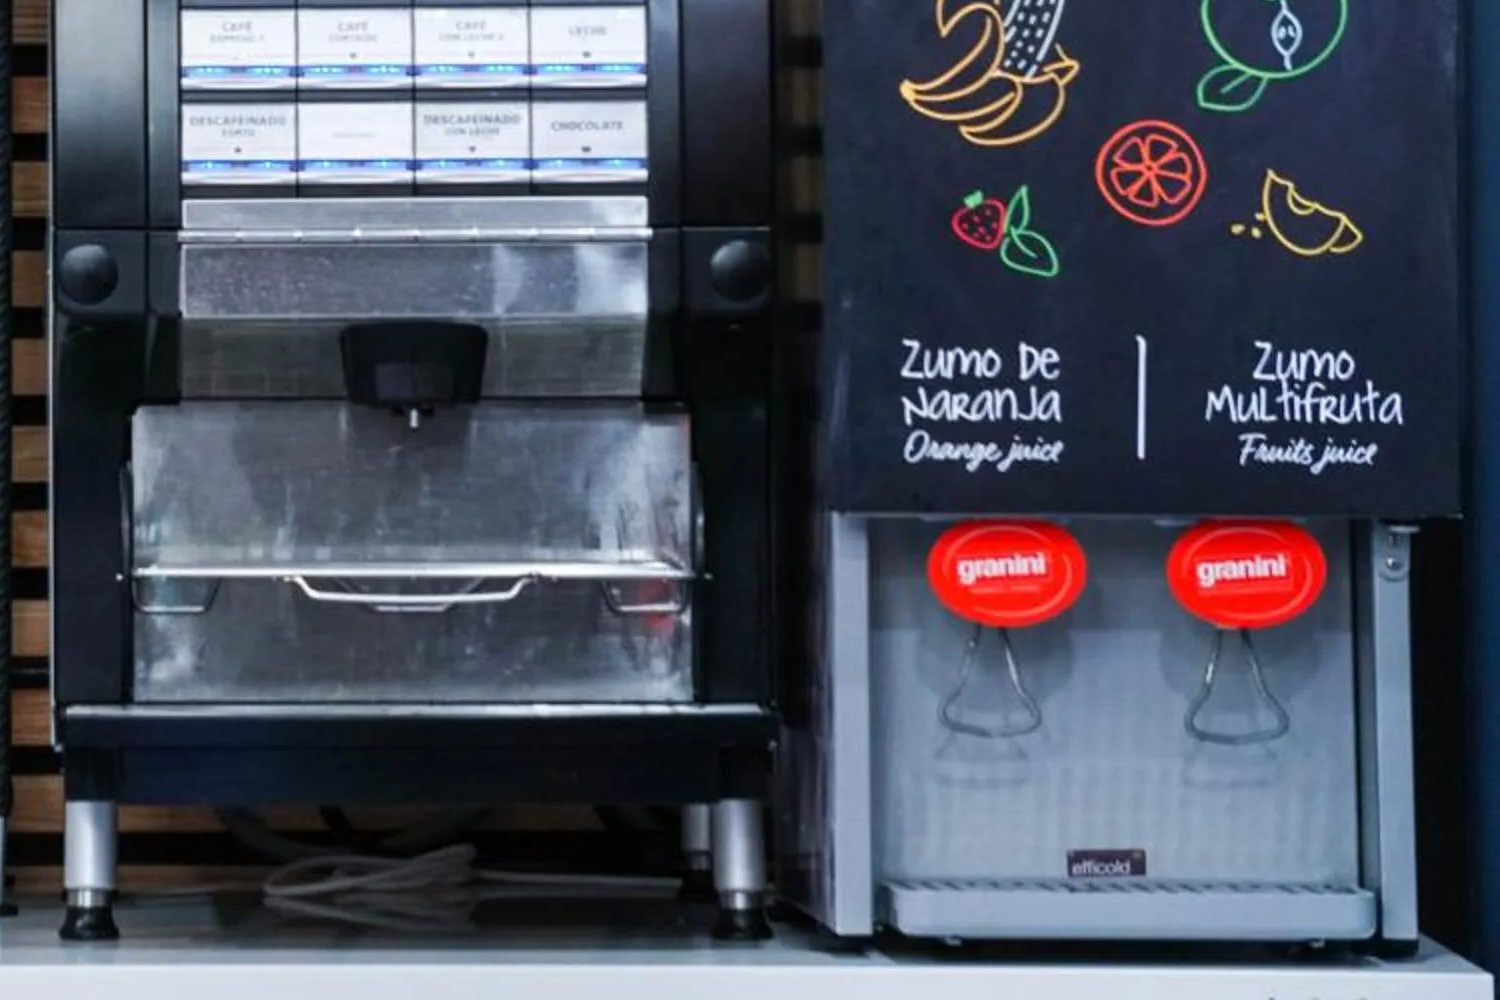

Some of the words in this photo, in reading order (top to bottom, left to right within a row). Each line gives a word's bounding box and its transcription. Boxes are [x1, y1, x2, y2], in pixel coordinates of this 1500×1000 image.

[189, 114, 288, 127] DESCAFEINADO
[423, 113, 522, 126] DESCAFEINADO
[550, 119, 624, 132] CHOCOLATE
[900, 338, 1002, 380] Zumo
[1252, 340, 1356, 382] Zumo
[903, 429, 1003, 473] Orange
[996, 434, 1065, 473] juice
[1238, 432, 1315, 468] Fruits
[1309, 436, 1379, 475] juice
[957, 551, 1047, 585] granini
[1196, 553, 1286, 588] granini
